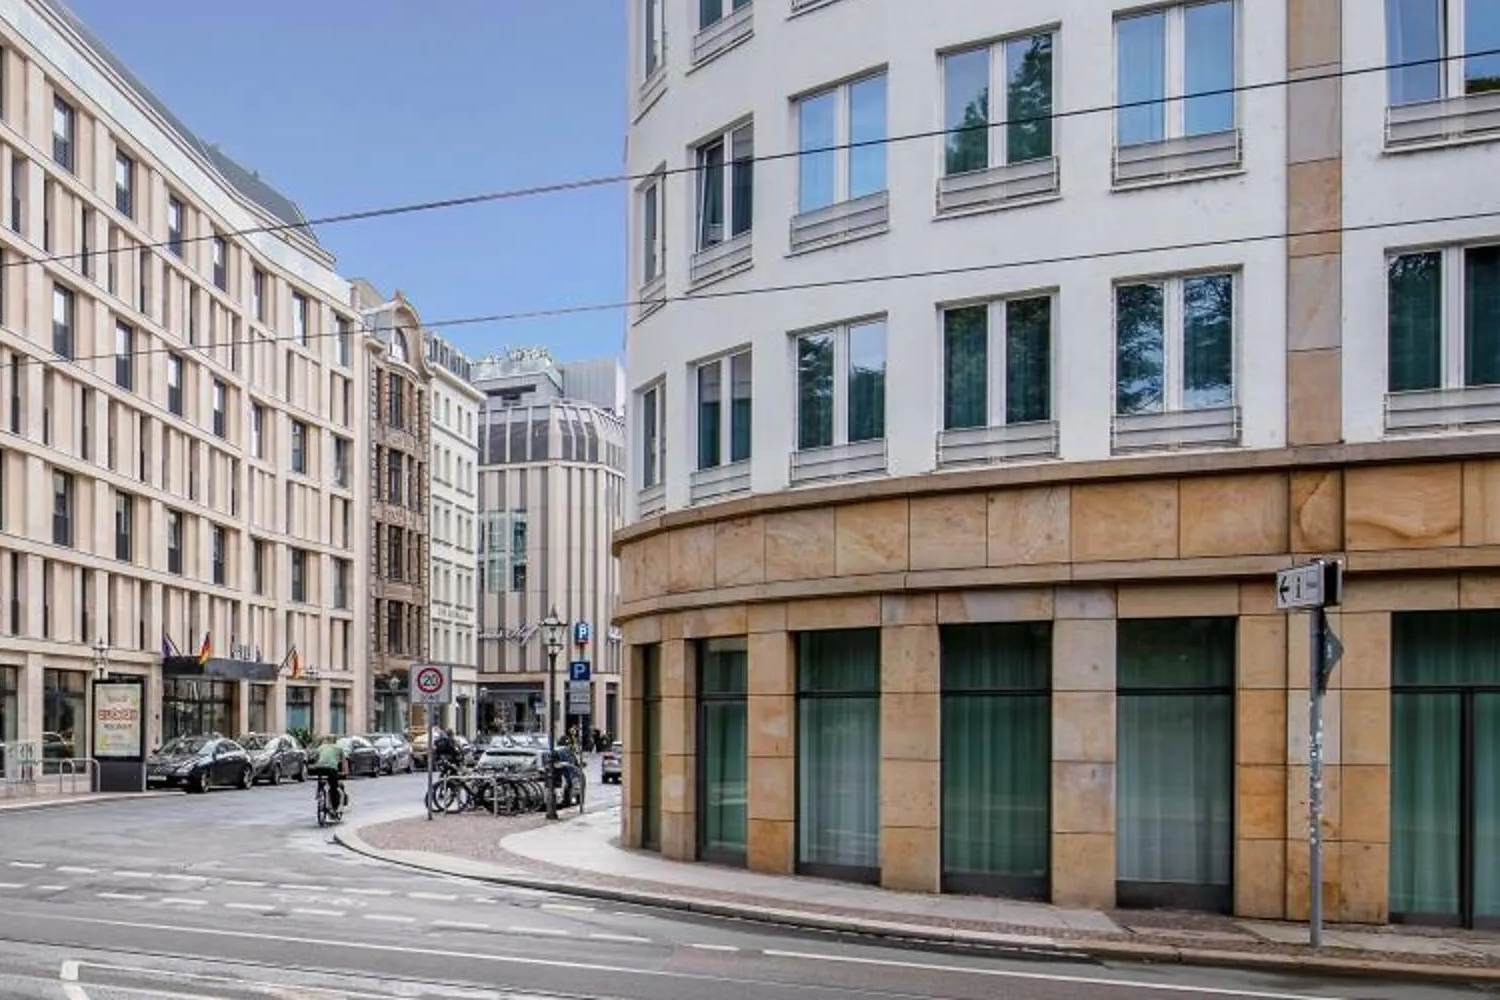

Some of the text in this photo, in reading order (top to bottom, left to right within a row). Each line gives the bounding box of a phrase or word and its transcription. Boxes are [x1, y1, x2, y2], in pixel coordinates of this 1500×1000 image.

[579, 623, 587, 639] P
[573, 663, 586, 679] P
[423, 674, 439, 686] 20
